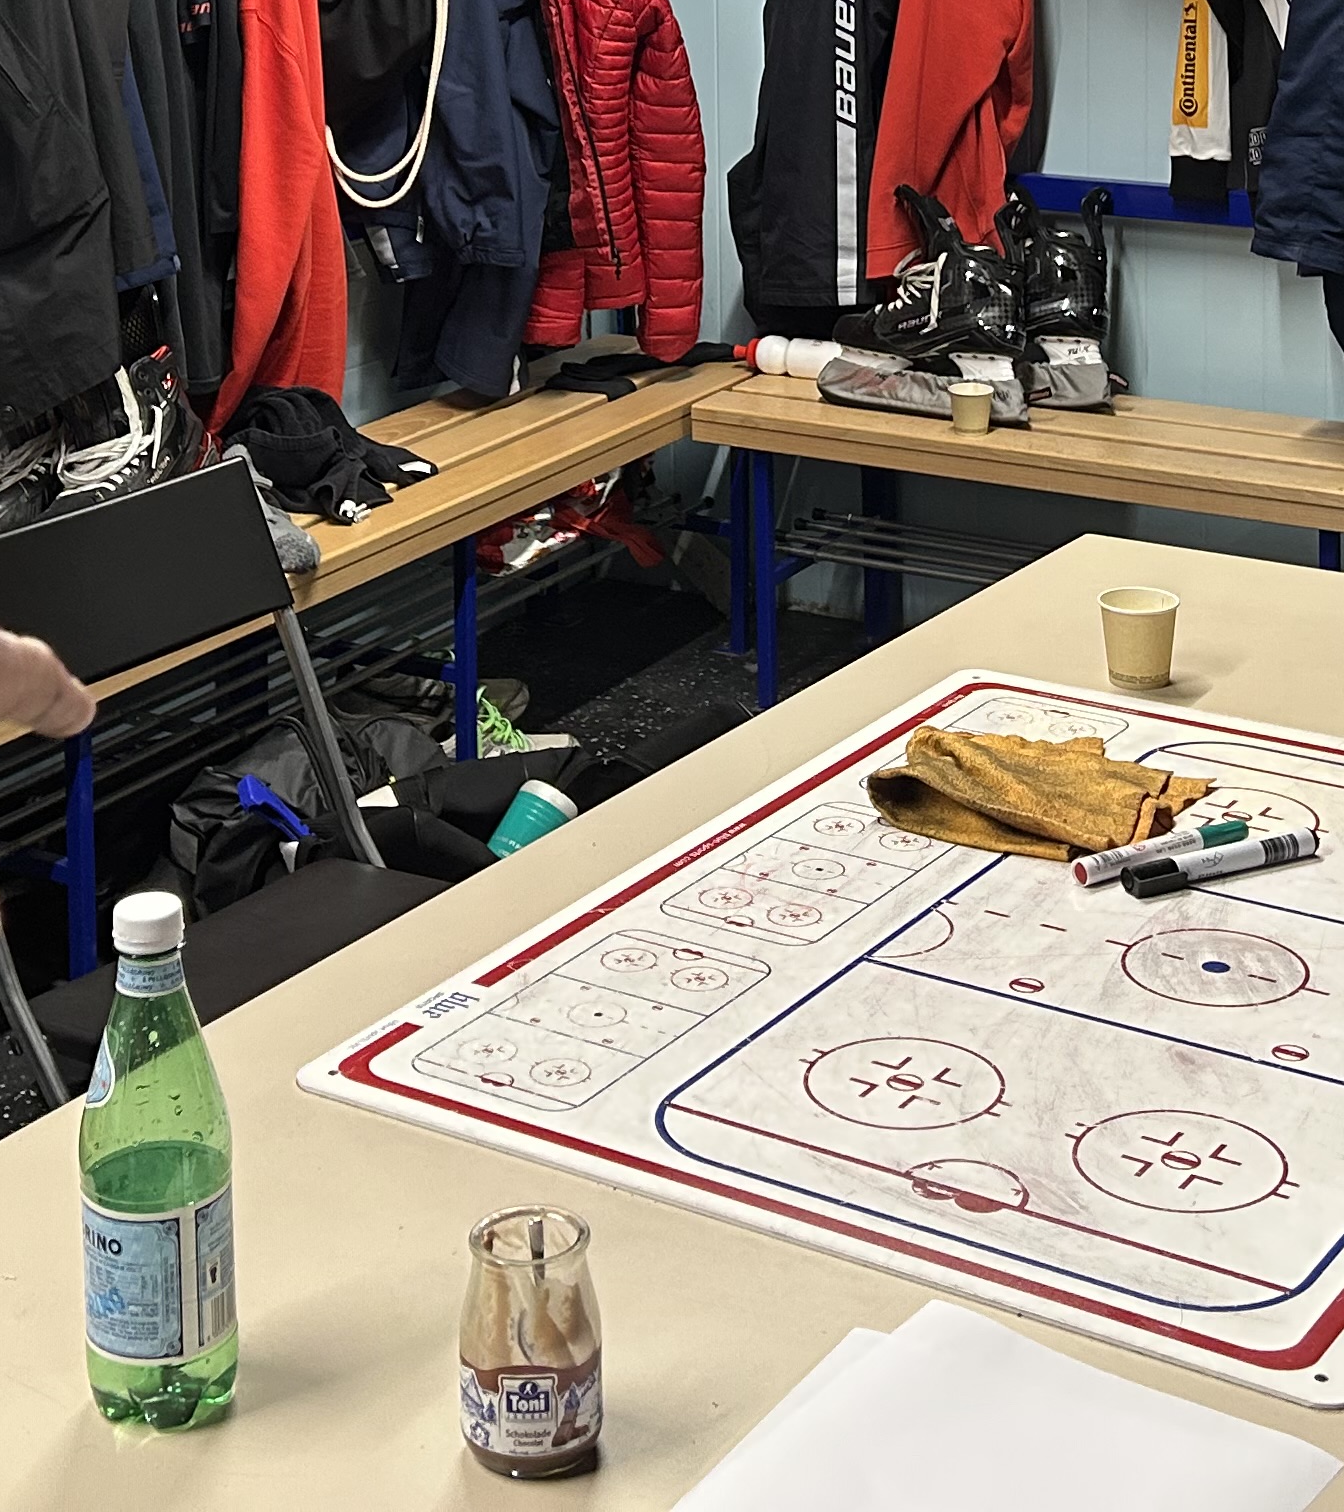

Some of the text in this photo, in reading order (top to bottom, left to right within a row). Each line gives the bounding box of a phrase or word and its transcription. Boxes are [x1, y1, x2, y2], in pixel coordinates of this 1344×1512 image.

[1179, 18, 1199, 118] Continental
[421, 990, 481, 1020] blue
[509, 1393, 546, 1413] Toni
[505, 1428, 552, 1439] Schokolade
